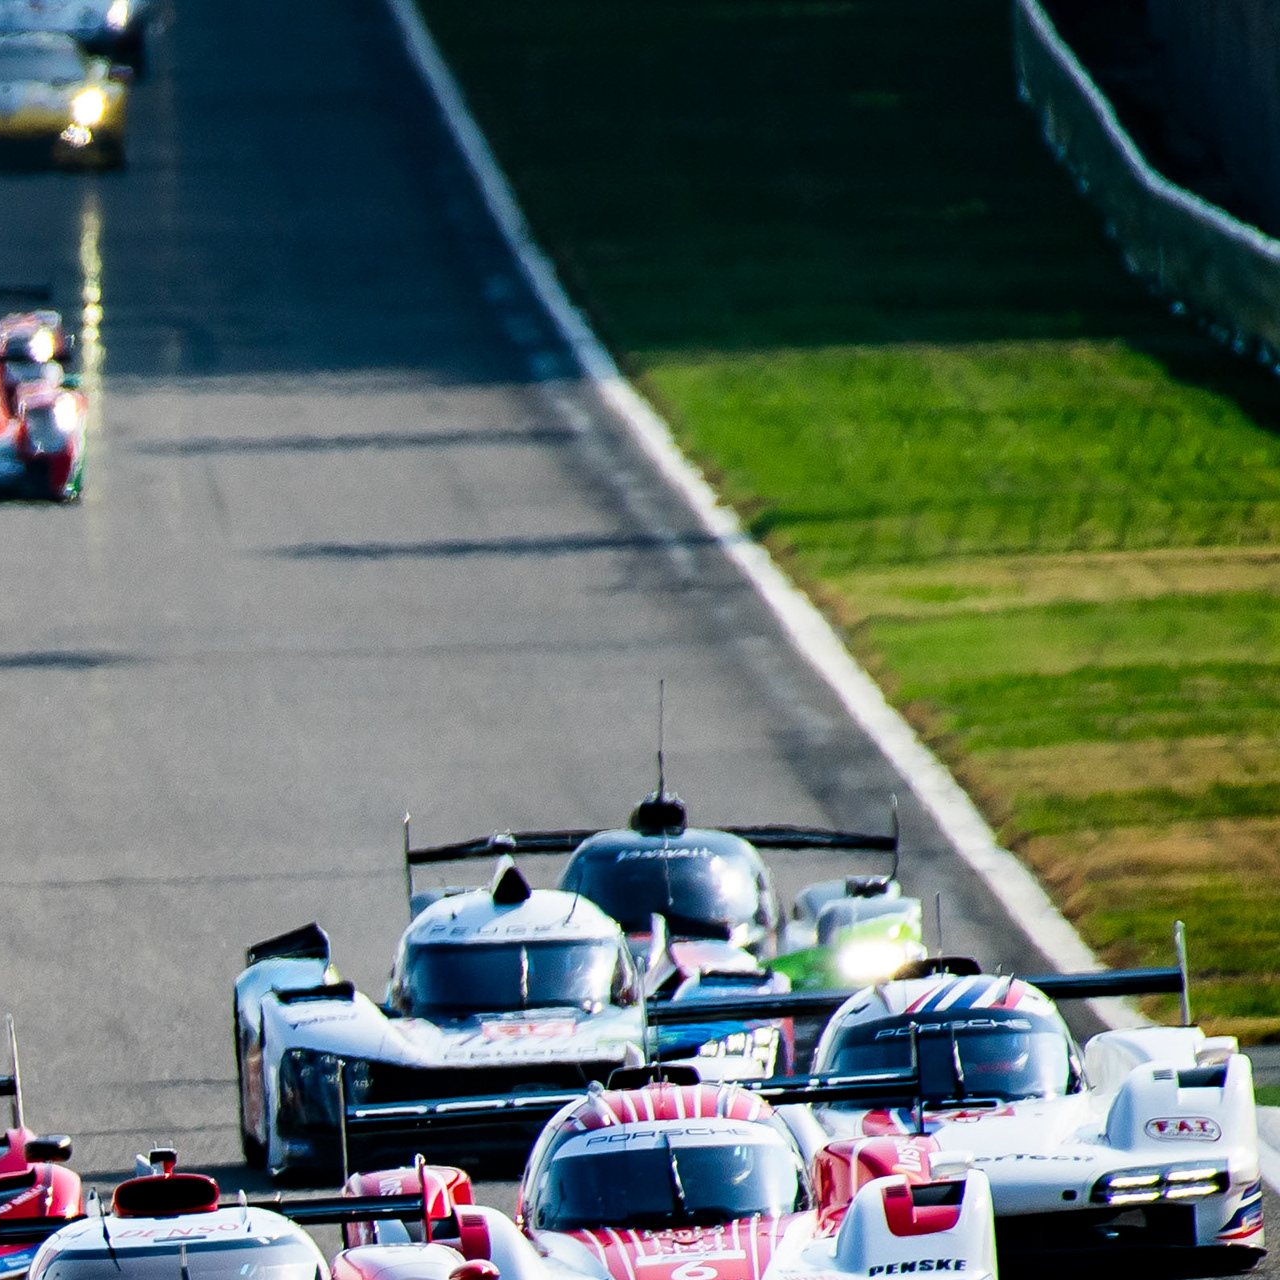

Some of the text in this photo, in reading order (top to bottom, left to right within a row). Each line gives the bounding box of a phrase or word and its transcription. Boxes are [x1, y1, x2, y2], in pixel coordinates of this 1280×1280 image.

[875, 1019, 1033, 1040] PORSCHE
[586, 1127, 756, 1148] PORSCHE
[116, 1223, 239, 1239] DENSO
[868, 1258, 968, 1278] PENSKE
